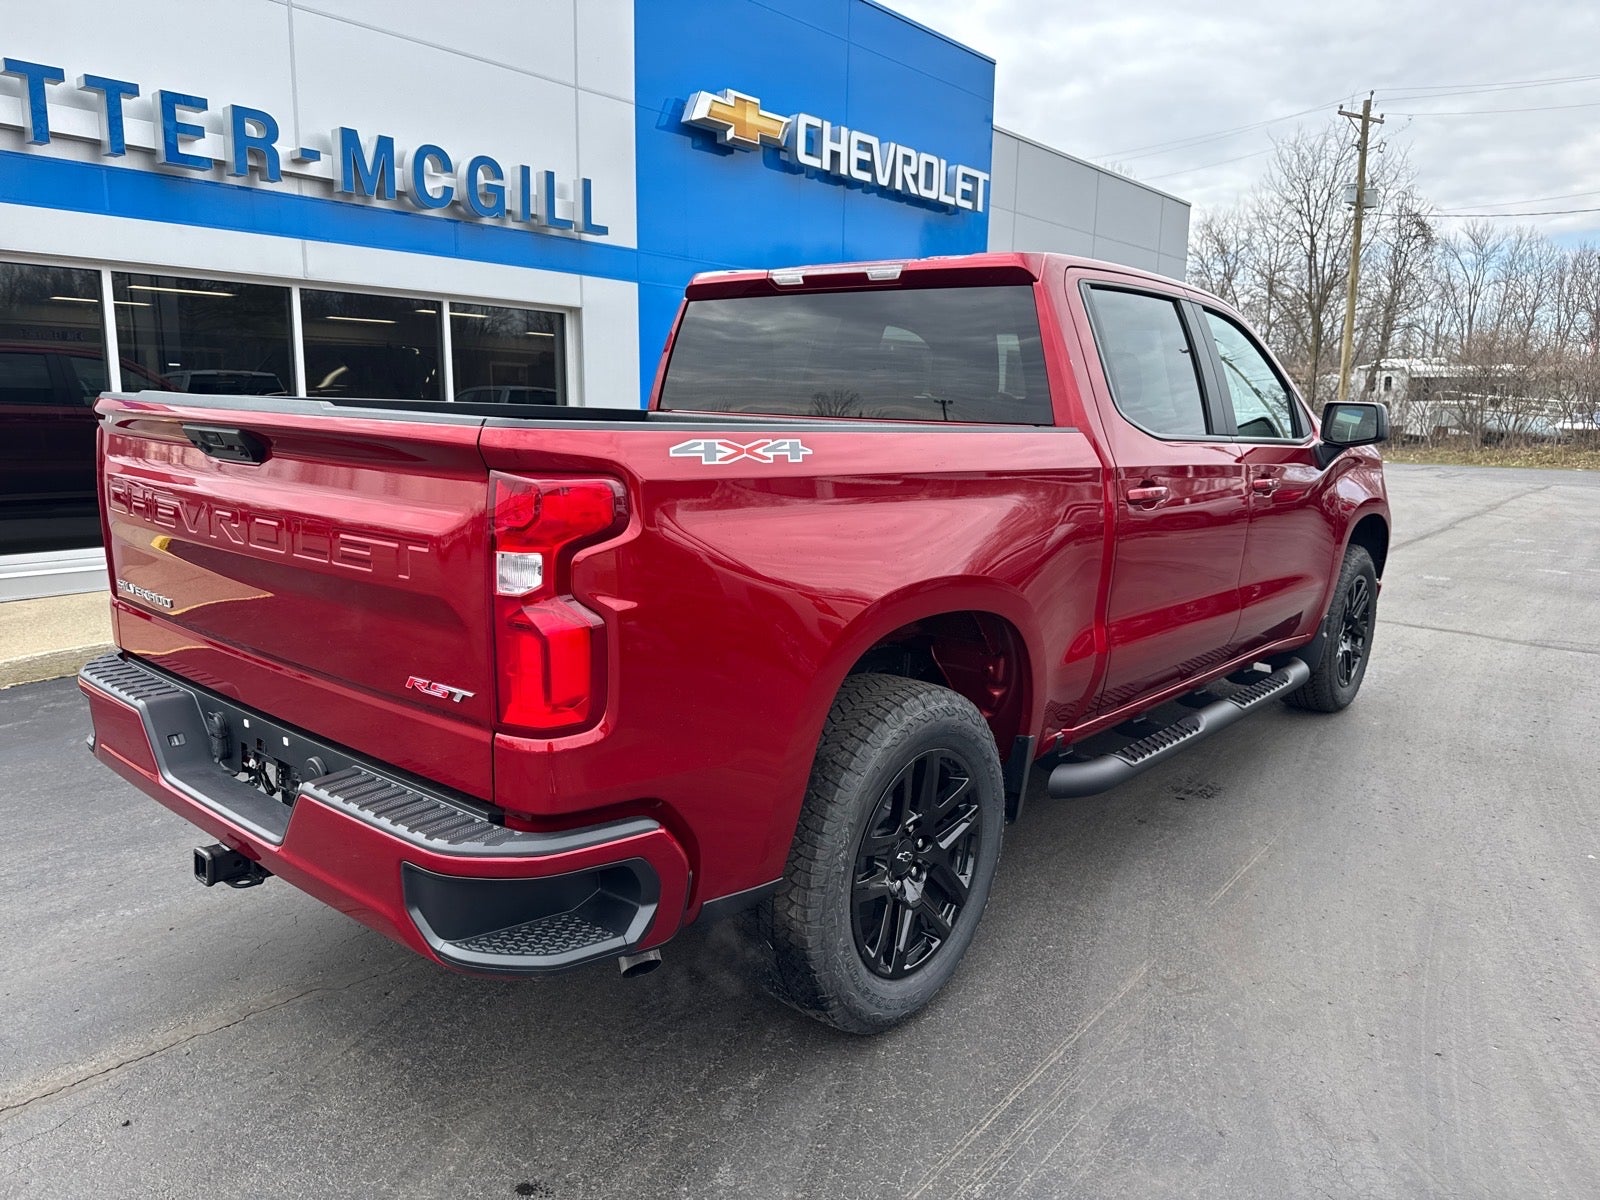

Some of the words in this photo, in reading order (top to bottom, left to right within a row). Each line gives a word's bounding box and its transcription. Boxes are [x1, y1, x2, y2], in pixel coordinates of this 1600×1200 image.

[796, 112, 990, 213] CHEVROLET
[108, 477, 430, 580] CHEVROLET
[117, 579, 174, 608] SILVERADO
[405, 676, 476, 702] RST
